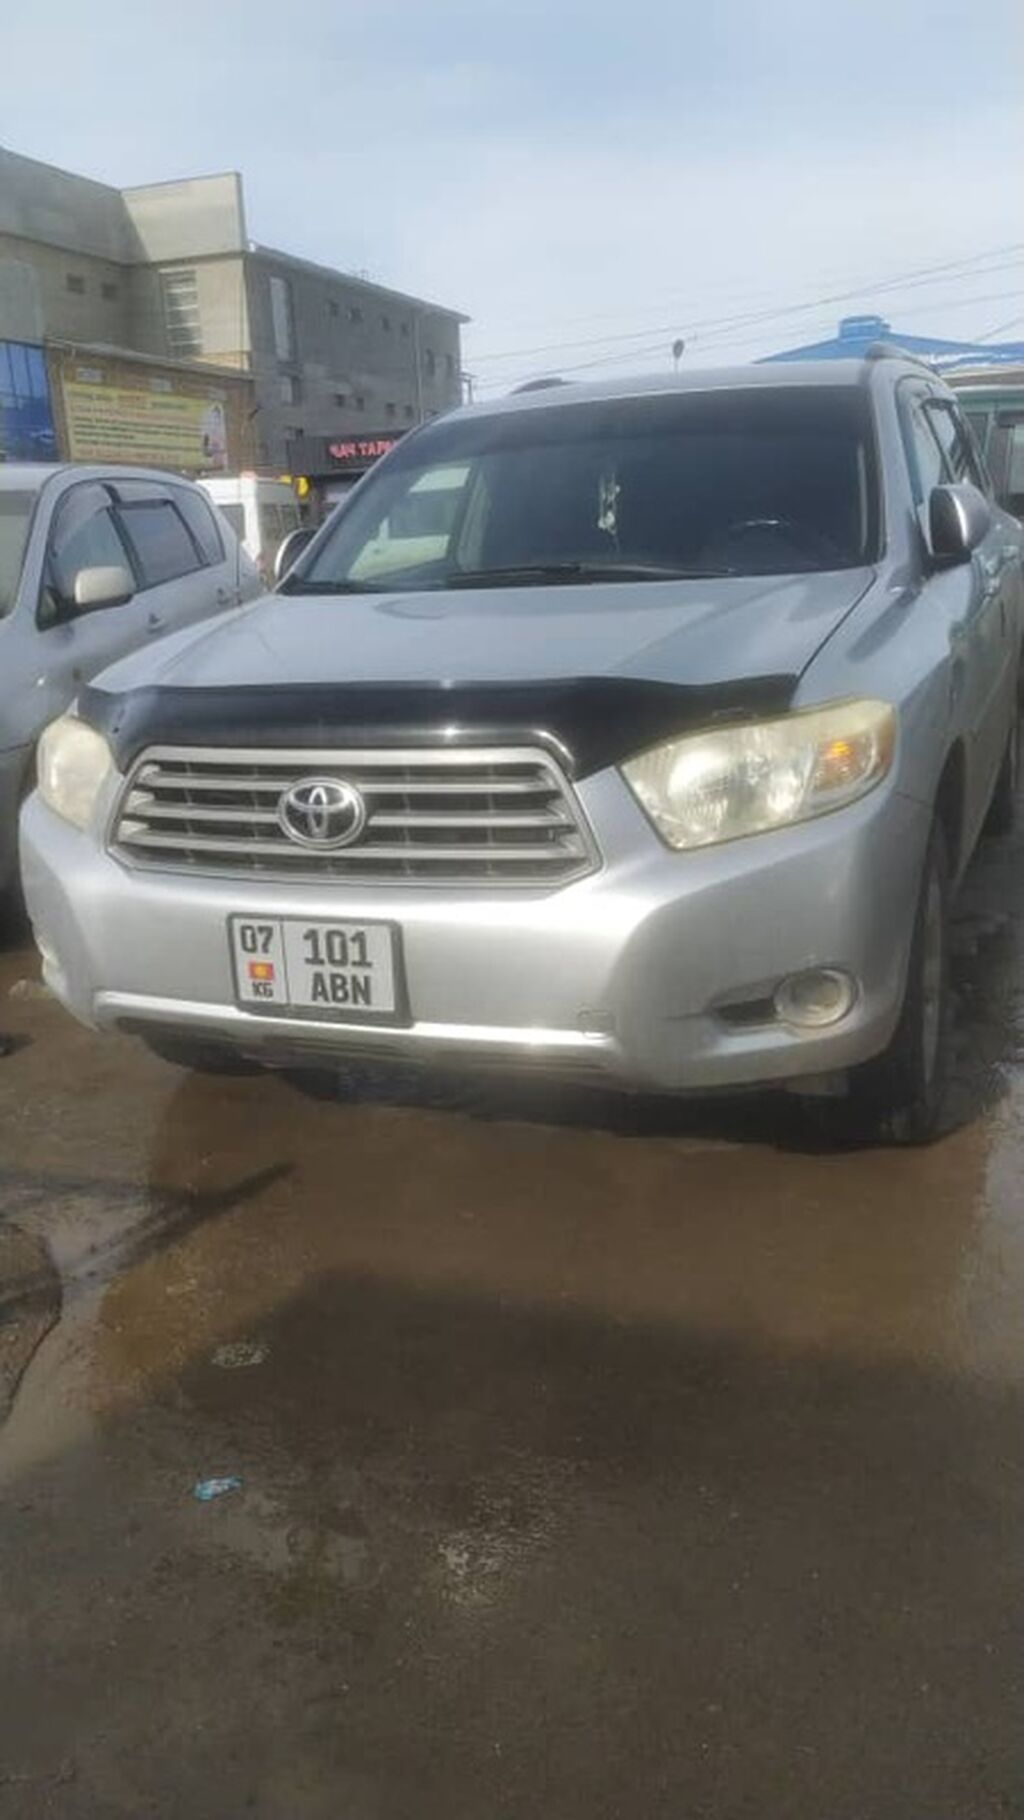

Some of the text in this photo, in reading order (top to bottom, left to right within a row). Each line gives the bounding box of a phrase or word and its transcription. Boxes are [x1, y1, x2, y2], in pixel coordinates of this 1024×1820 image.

[240, 925, 275, 954] 07
[303, 929, 373, 968] 101
[311, 972, 371, 1005] ABN
